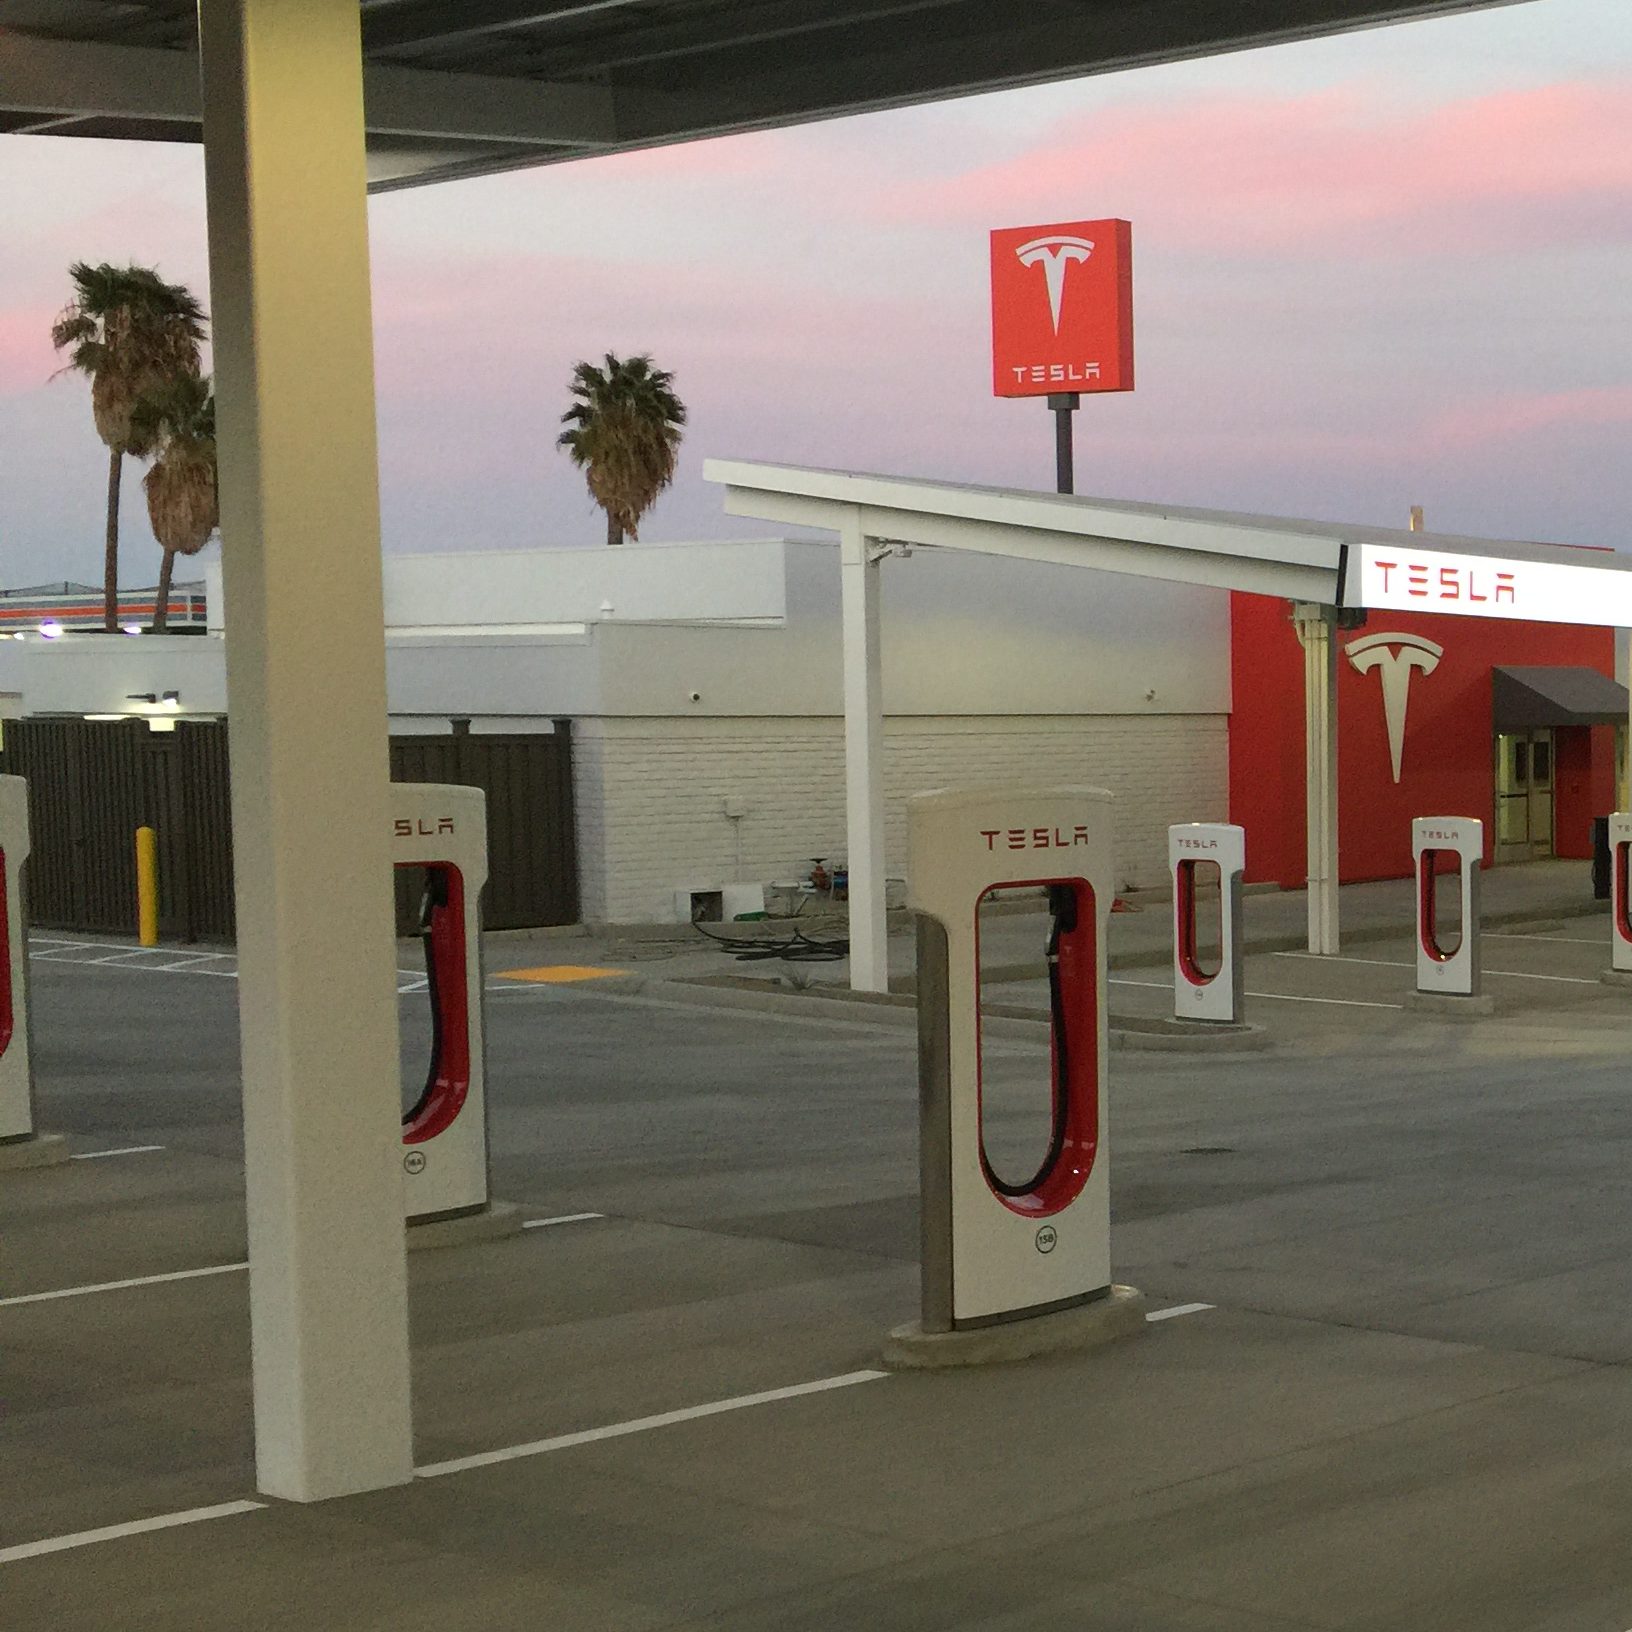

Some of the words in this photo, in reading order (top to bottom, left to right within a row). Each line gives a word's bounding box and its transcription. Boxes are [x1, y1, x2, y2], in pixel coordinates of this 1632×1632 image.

[1012, 361, 1100, 384] TESLA
[1374, 560, 1515, 604] TESLA
[393, 818, 455, 837] SLA
[1421, 830, 1459, 840] TESLA
[980, 826, 1088, 851] TESLA
[1177, 839, 1218, 849] TESLA
